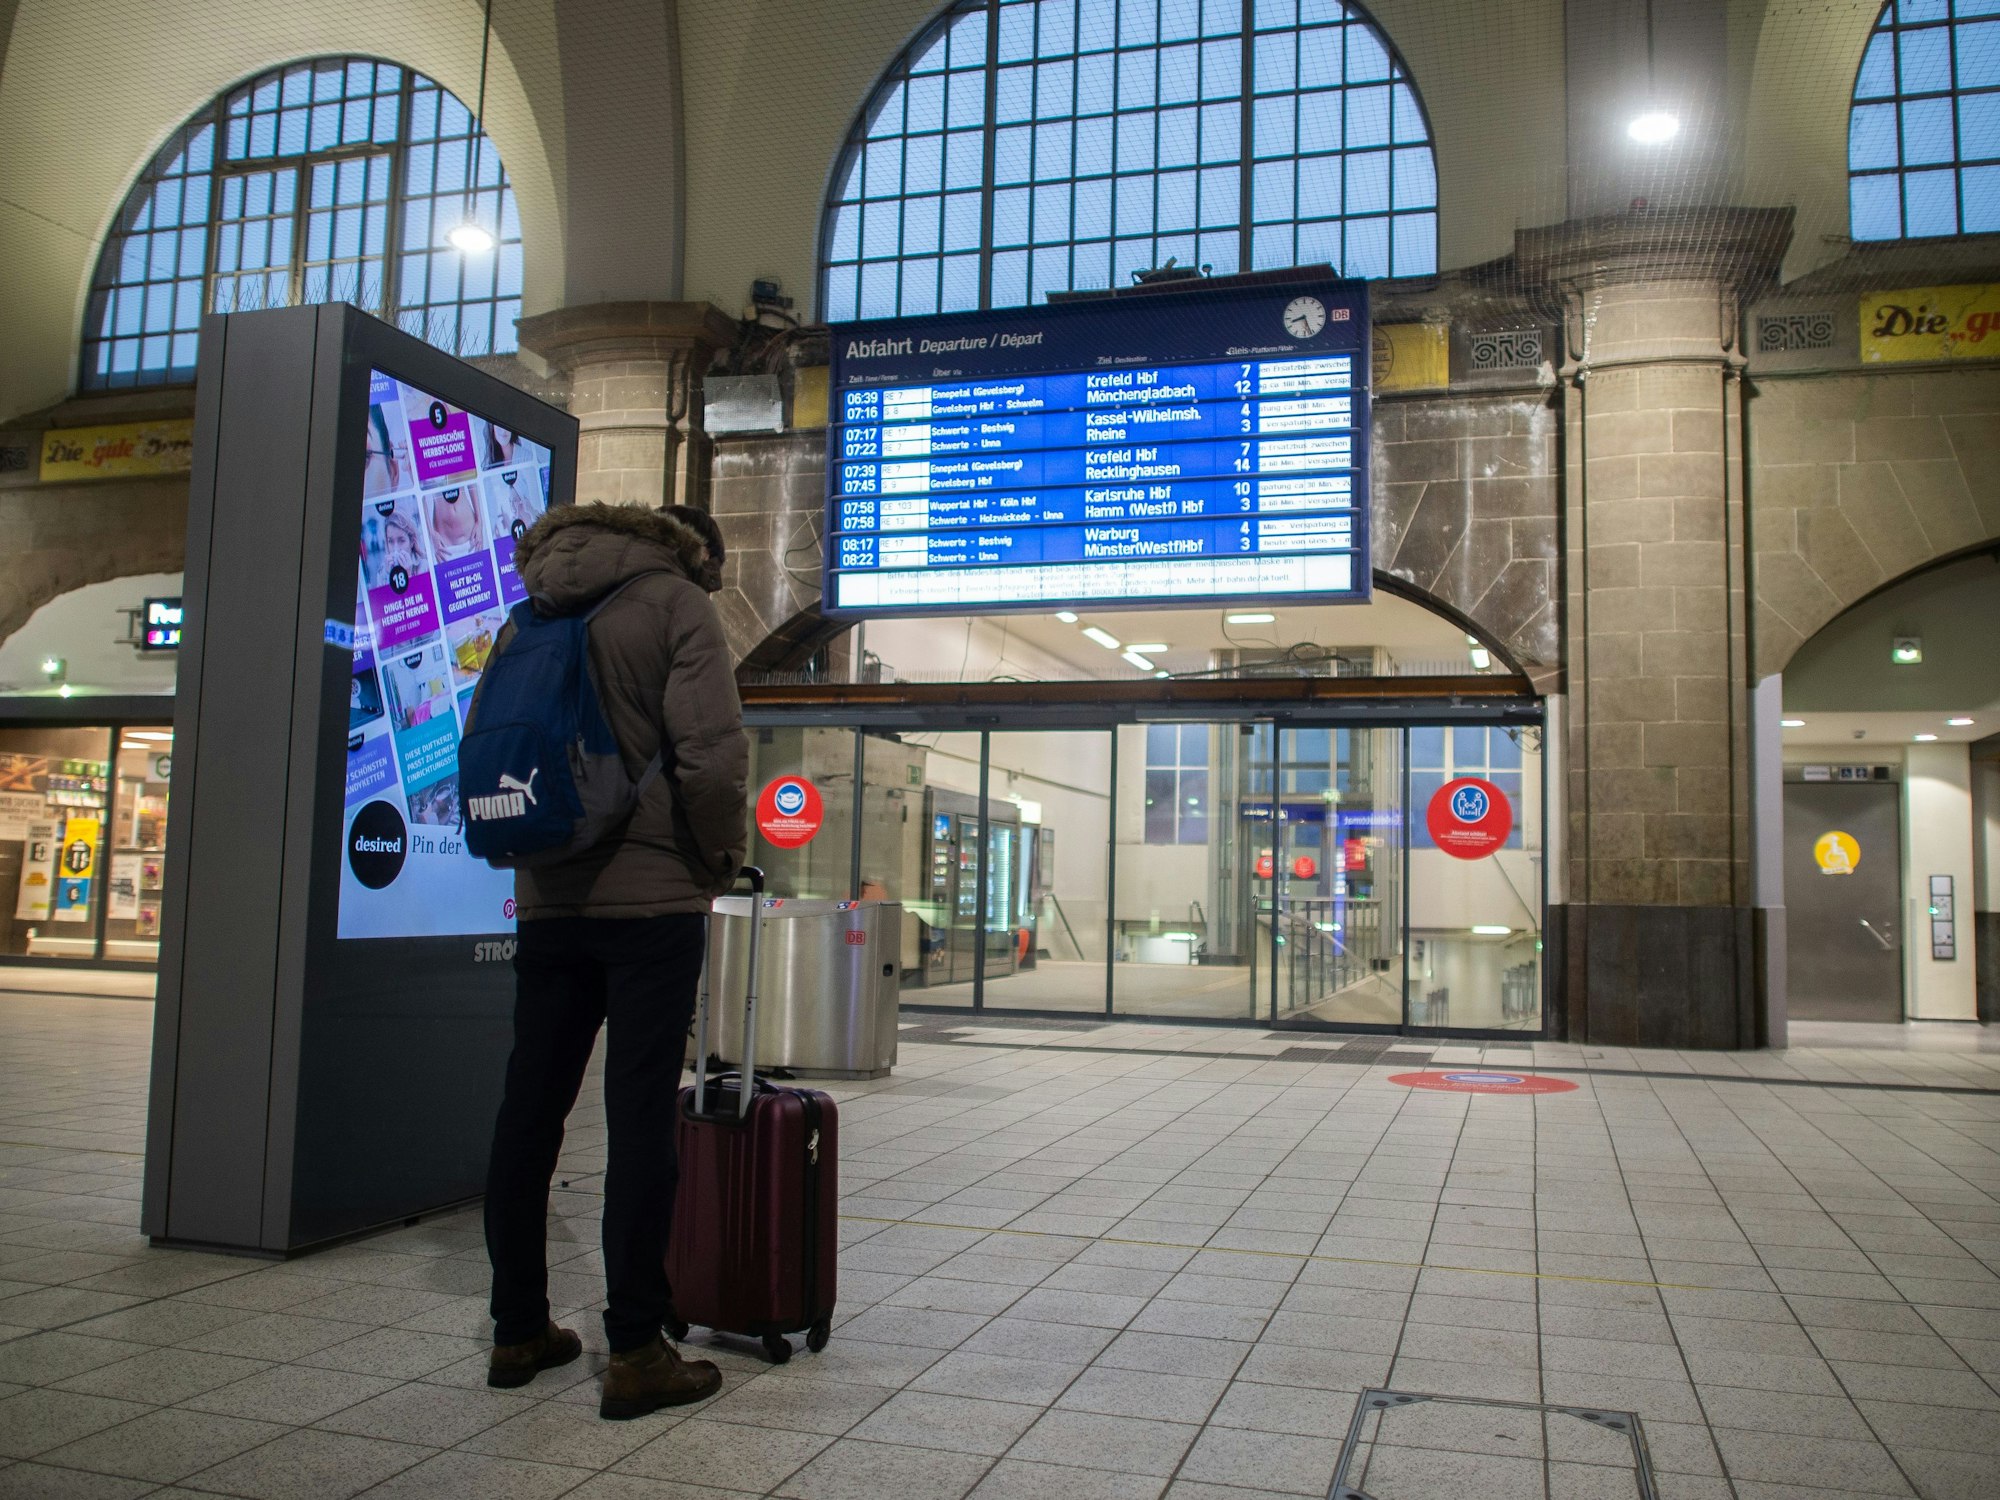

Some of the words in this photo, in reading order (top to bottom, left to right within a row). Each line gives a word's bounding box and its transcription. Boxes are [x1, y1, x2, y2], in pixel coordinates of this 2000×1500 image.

[1333, 309, 1350, 321] DB
[1872, 305, 1948, 338] Die
[846, 337, 912, 359] Abfahrt
[919, 336, 988, 354] Departure
[1000, 331, 1043, 348] Départ
[847, 391, 878, 405] 06:39
[932, 387, 971, 400] Ennepetal
[973, 383, 1025, 397] (Gevelsberg)
[1087, 371, 1132, 388] Krefeld
[1136, 371, 1159, 386] Hbf
[1240, 363, 1251, 378] 7
[849, 374, 863, 384] Zeit
[932, 367, 951, 378] Über
[847, 406, 878, 420] 07:16
[932, 402, 977, 415] Gevelsberg
[979, 401, 994, 412] Hbf
[1006, 398, 1044, 410] Schwelm
[1087, 384, 1196, 403] Mönchengladbach
[1234, 380, 1251, 394] 12
[434, 408, 442, 424] 5
[846, 427, 877, 441] 07:17
[931, 425, 970, 437] Schwerte
[981, 422, 1015, 436] Bestwig
[1087, 406, 1202, 427] Kassel-Wilhelmsh.
[1240, 402, 1251, 417] 4
[45, 438, 84, 464] Die
[418, 429, 466, 448] WUNDERSCHÖNE
[422, 441, 466, 459] HERBST-LOOKS
[845, 443, 877, 456] 07:22
[931, 440, 970, 452] Schwerte
[981, 438, 1002, 449] Unna
[1086, 427, 1127, 442] Rheine
[1240, 419, 1251, 432] 3
[845, 464, 876, 478] 07:39
[930, 462, 969, 475] Ennepetal
[971, 458, 1024, 472] (Gevelsberg)
[1085, 448, 1131, 464] Krefeld
[1135, 447, 1158, 462] Hbf
[1240, 442, 1251, 457] 7
[844, 480, 876, 493] 07:45
[930, 477, 975, 490] Gevelsberg
[978, 475, 993, 487] Hbf
[1085, 464, 1181, 481] Recklinghausen
[1233, 458, 1250, 473] 14
[843, 501, 875, 515] 07:58
[929, 500, 970, 512] Wuppertal
[973, 499, 988, 509] Hbf
[1000, 496, 1019, 508] Köln
[1021, 495, 1037, 506] Hbf
[1085, 487, 1146, 503] Karlsruhe
[1150, 485, 1172, 500] Hbf
[1233, 481, 1250, 496] 10
[843, 516, 875, 529] 07:58
[928, 514, 968, 526] Schwerte
[979, 511, 1031, 524] Holzwickede
[1043, 510, 1064, 521] Unna
[1085, 504, 1124, 519] Hamm
[1129, 500, 1178, 517] (Westf)
[1182, 499, 1205, 514] Hbf
[1240, 497, 1250, 511] 3
[842, 538, 874, 551] 08:17
[928, 537, 967, 549] Schwerte
[978, 535, 1013, 548] Bestwig
[1085, 526, 1140, 543] Warburg
[1240, 520, 1250, 535] 4
[842, 553, 874, 566] 08:22
[928, 552, 967, 564] Schwerte
[978, 551, 999, 562] Unna
[1085, 538, 1205, 557] Münster(Westf)Hbf
[1240, 536, 1250, 551] 3
[392, 571, 407, 589] 18
[449, 577, 466, 590] HILFT
[454, 584, 482, 600] WIRKLICH
[382, 612, 406, 628] HERBST
[405, 602, 429, 618] NERVEN
[383, 598, 404, 615] DINGE,
[404, 595, 415, 609] DIE
[448, 597, 467, 614] GEGEN
[467, 590, 491, 607] NARBEN?
[405, 747, 421, 761] DIESE
[421, 731, 454, 752] DUFTKERZE
[407, 757, 426, 771] PASST
[426, 752, 434, 763] ZU
[434, 743, 456, 758] DEINEM
[349, 755, 388, 782] SCHÖNSTEN
[345, 769, 386, 796] ANDYKETTEN
[468, 792, 526, 821] PUMA
[355, 835, 401, 853] desired
[412, 834, 434, 853] Pin
[439, 835, 462, 855] der
[846, 931, 865, 945] DB
